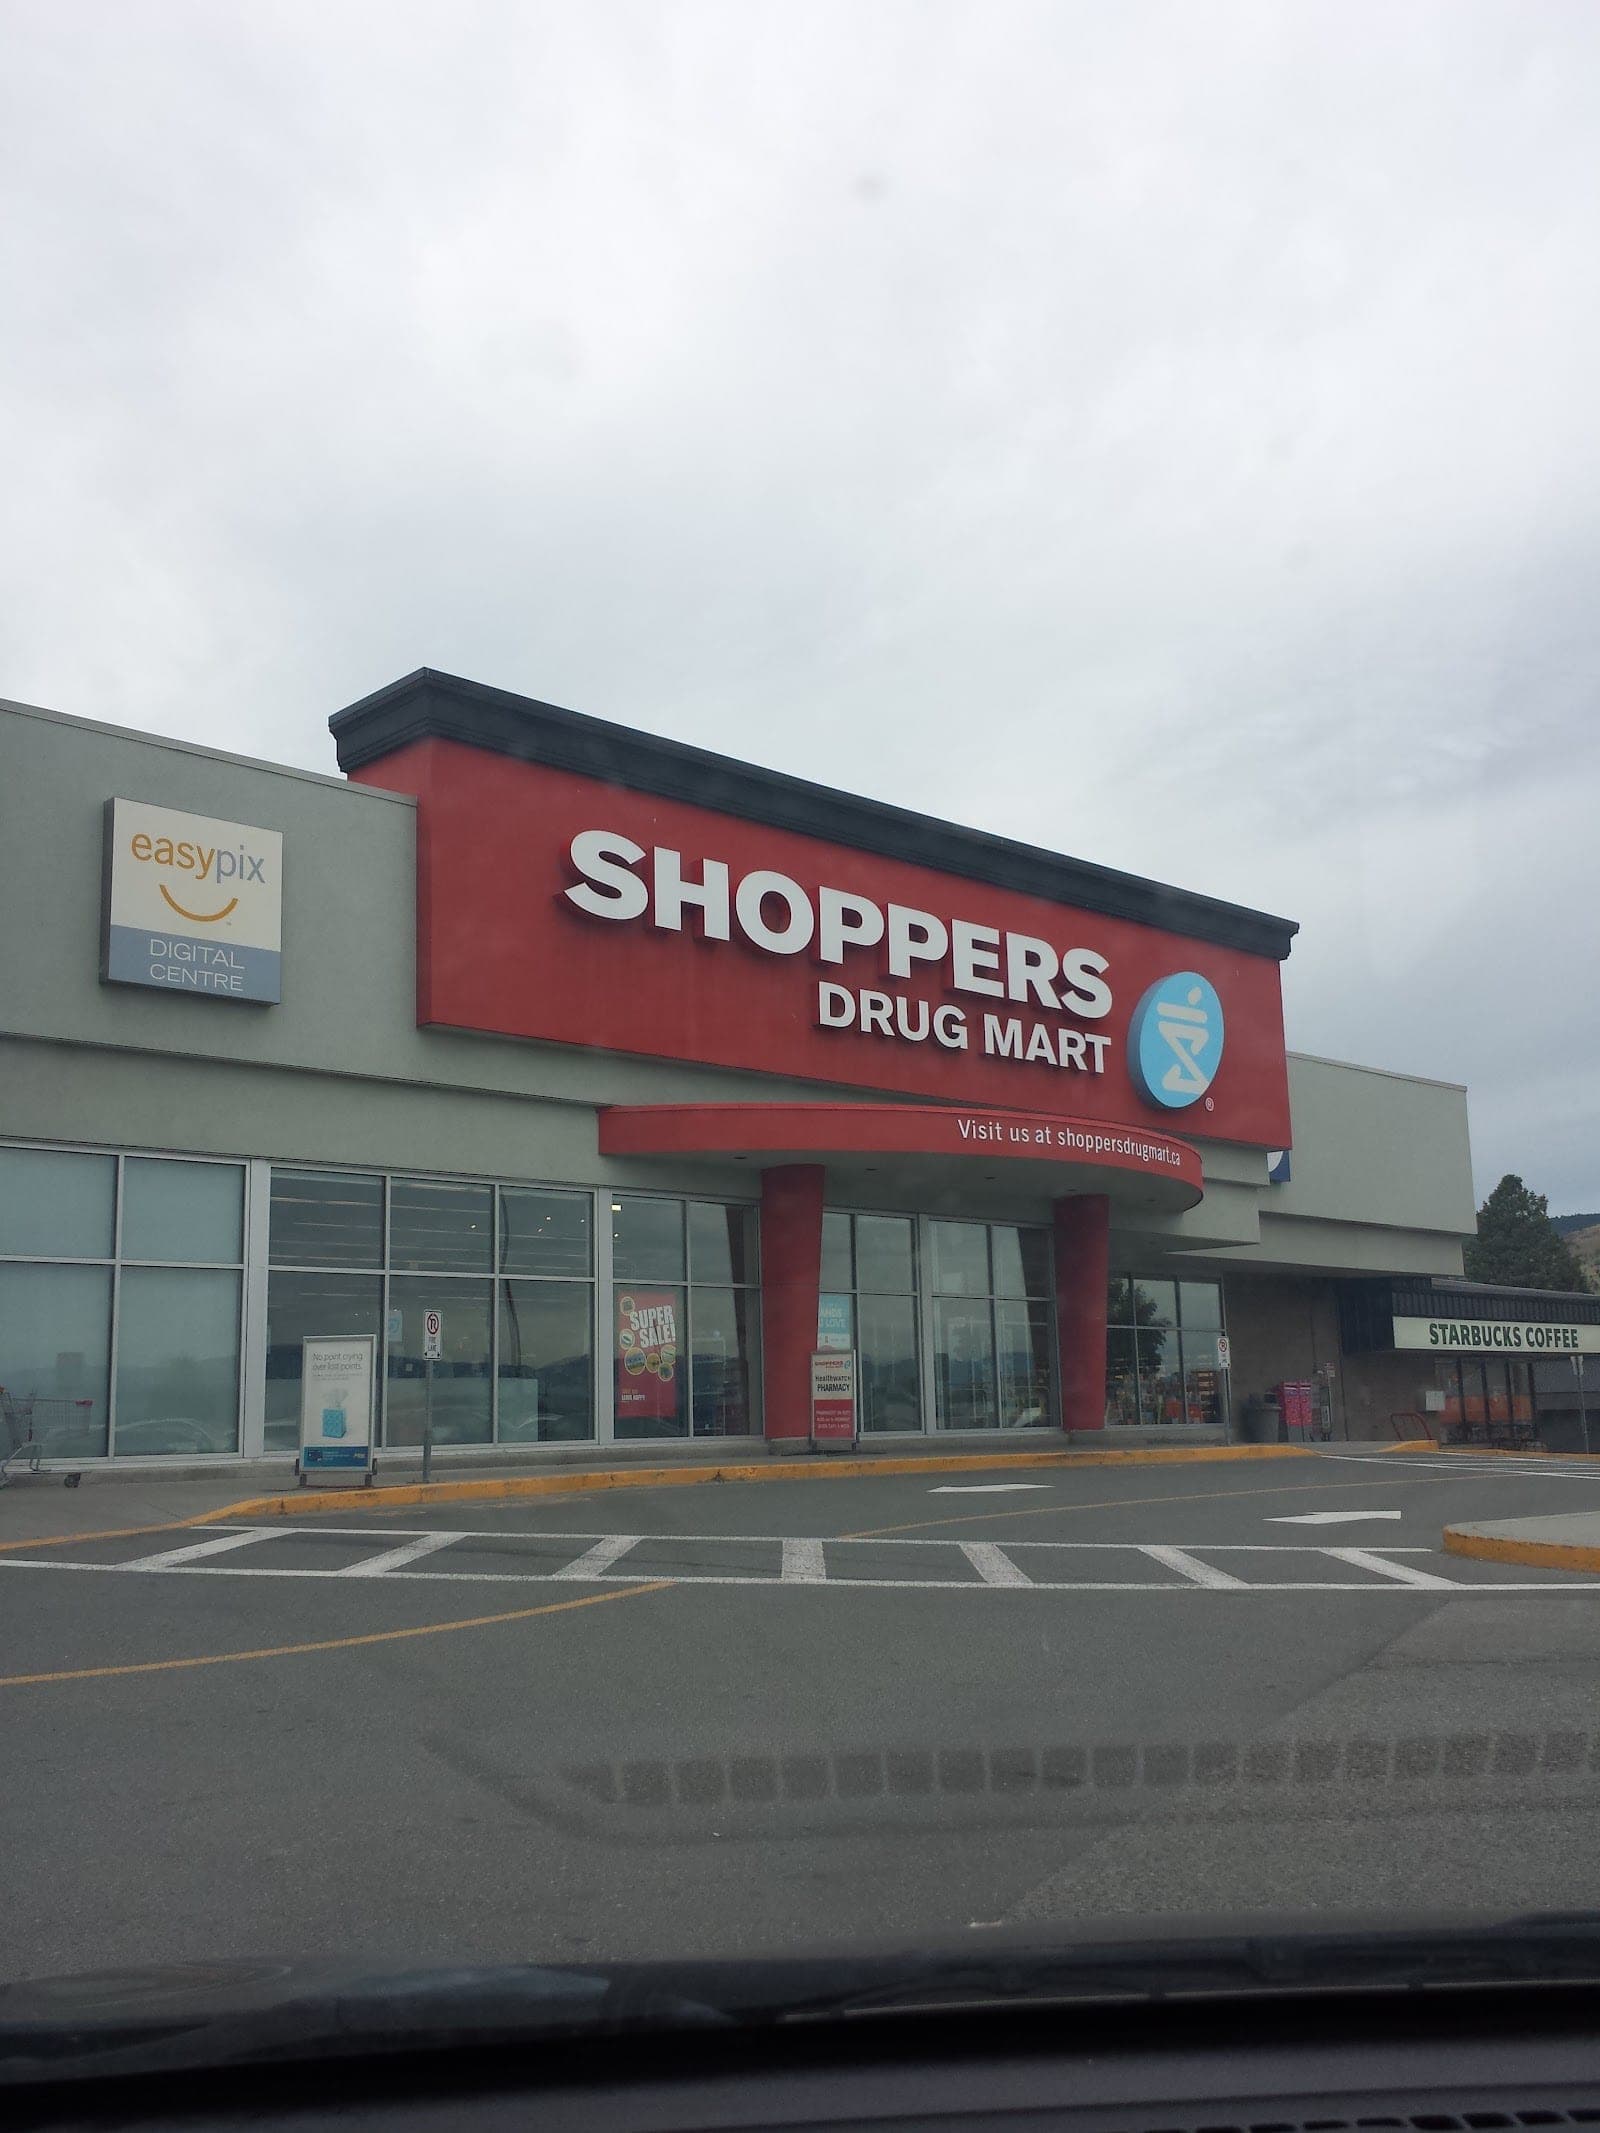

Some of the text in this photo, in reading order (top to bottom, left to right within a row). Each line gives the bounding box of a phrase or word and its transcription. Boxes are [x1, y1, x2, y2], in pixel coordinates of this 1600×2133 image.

[131, 833, 266, 884] easypix
[564, 830, 1113, 1018] SHOPPERS
[150, 938, 245, 969] DIGITAL
[150, 963, 244, 991] CENTRE
[818, 980, 1112, 1073] DRUG MART
[957, 1119, 1181, 1166] Visit us at shoppersdrugmart.ca
[630, 1305, 674, 1331] SUPER
[640, 1322, 676, 1349] SALE!
[1429, 1323, 1579, 1348] STARBUCKS COFFEE
[313, 1352, 363, 1362] No point crying
[327, 1362, 339, 1370] lost
[817, 1383, 850, 1392] PHARMACY
